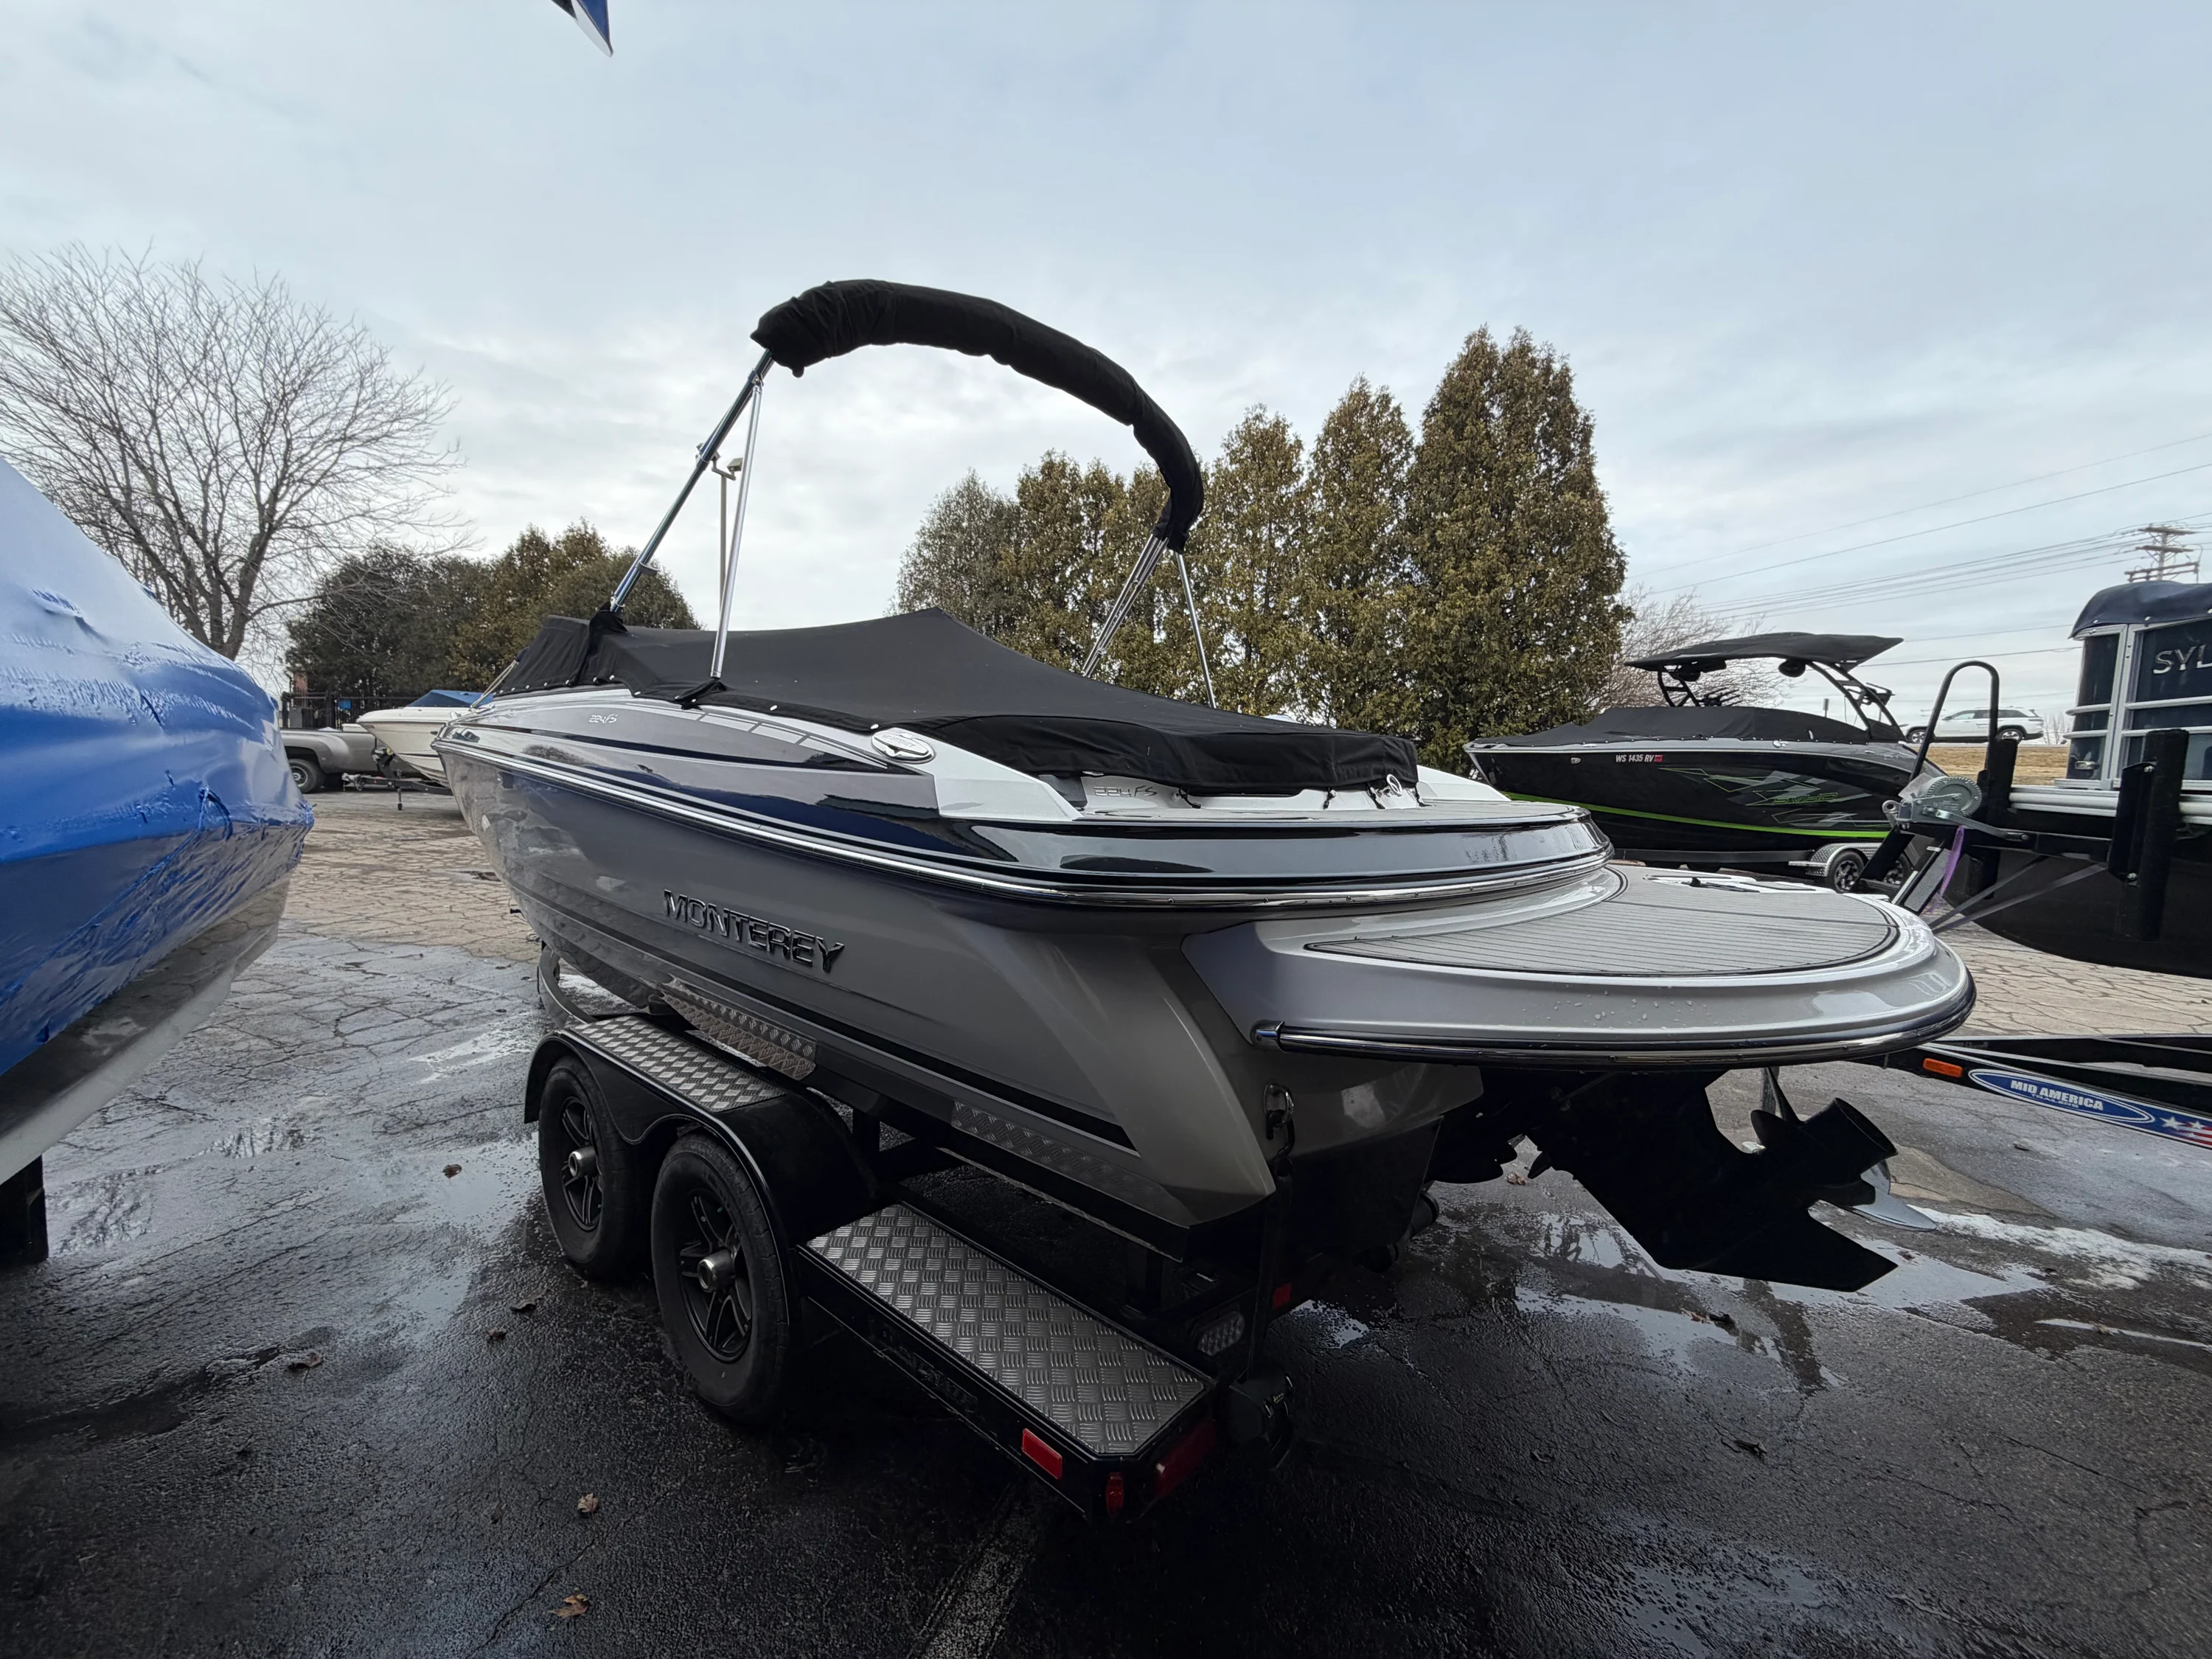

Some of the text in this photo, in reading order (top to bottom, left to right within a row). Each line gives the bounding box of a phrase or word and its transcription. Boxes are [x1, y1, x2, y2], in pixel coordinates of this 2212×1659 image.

[1615, 754, 1655, 762] WS 1435 RV
[664, 888, 845, 974] MONTEREY
[2010, 1080, 2104, 1110] MID AMERICA
